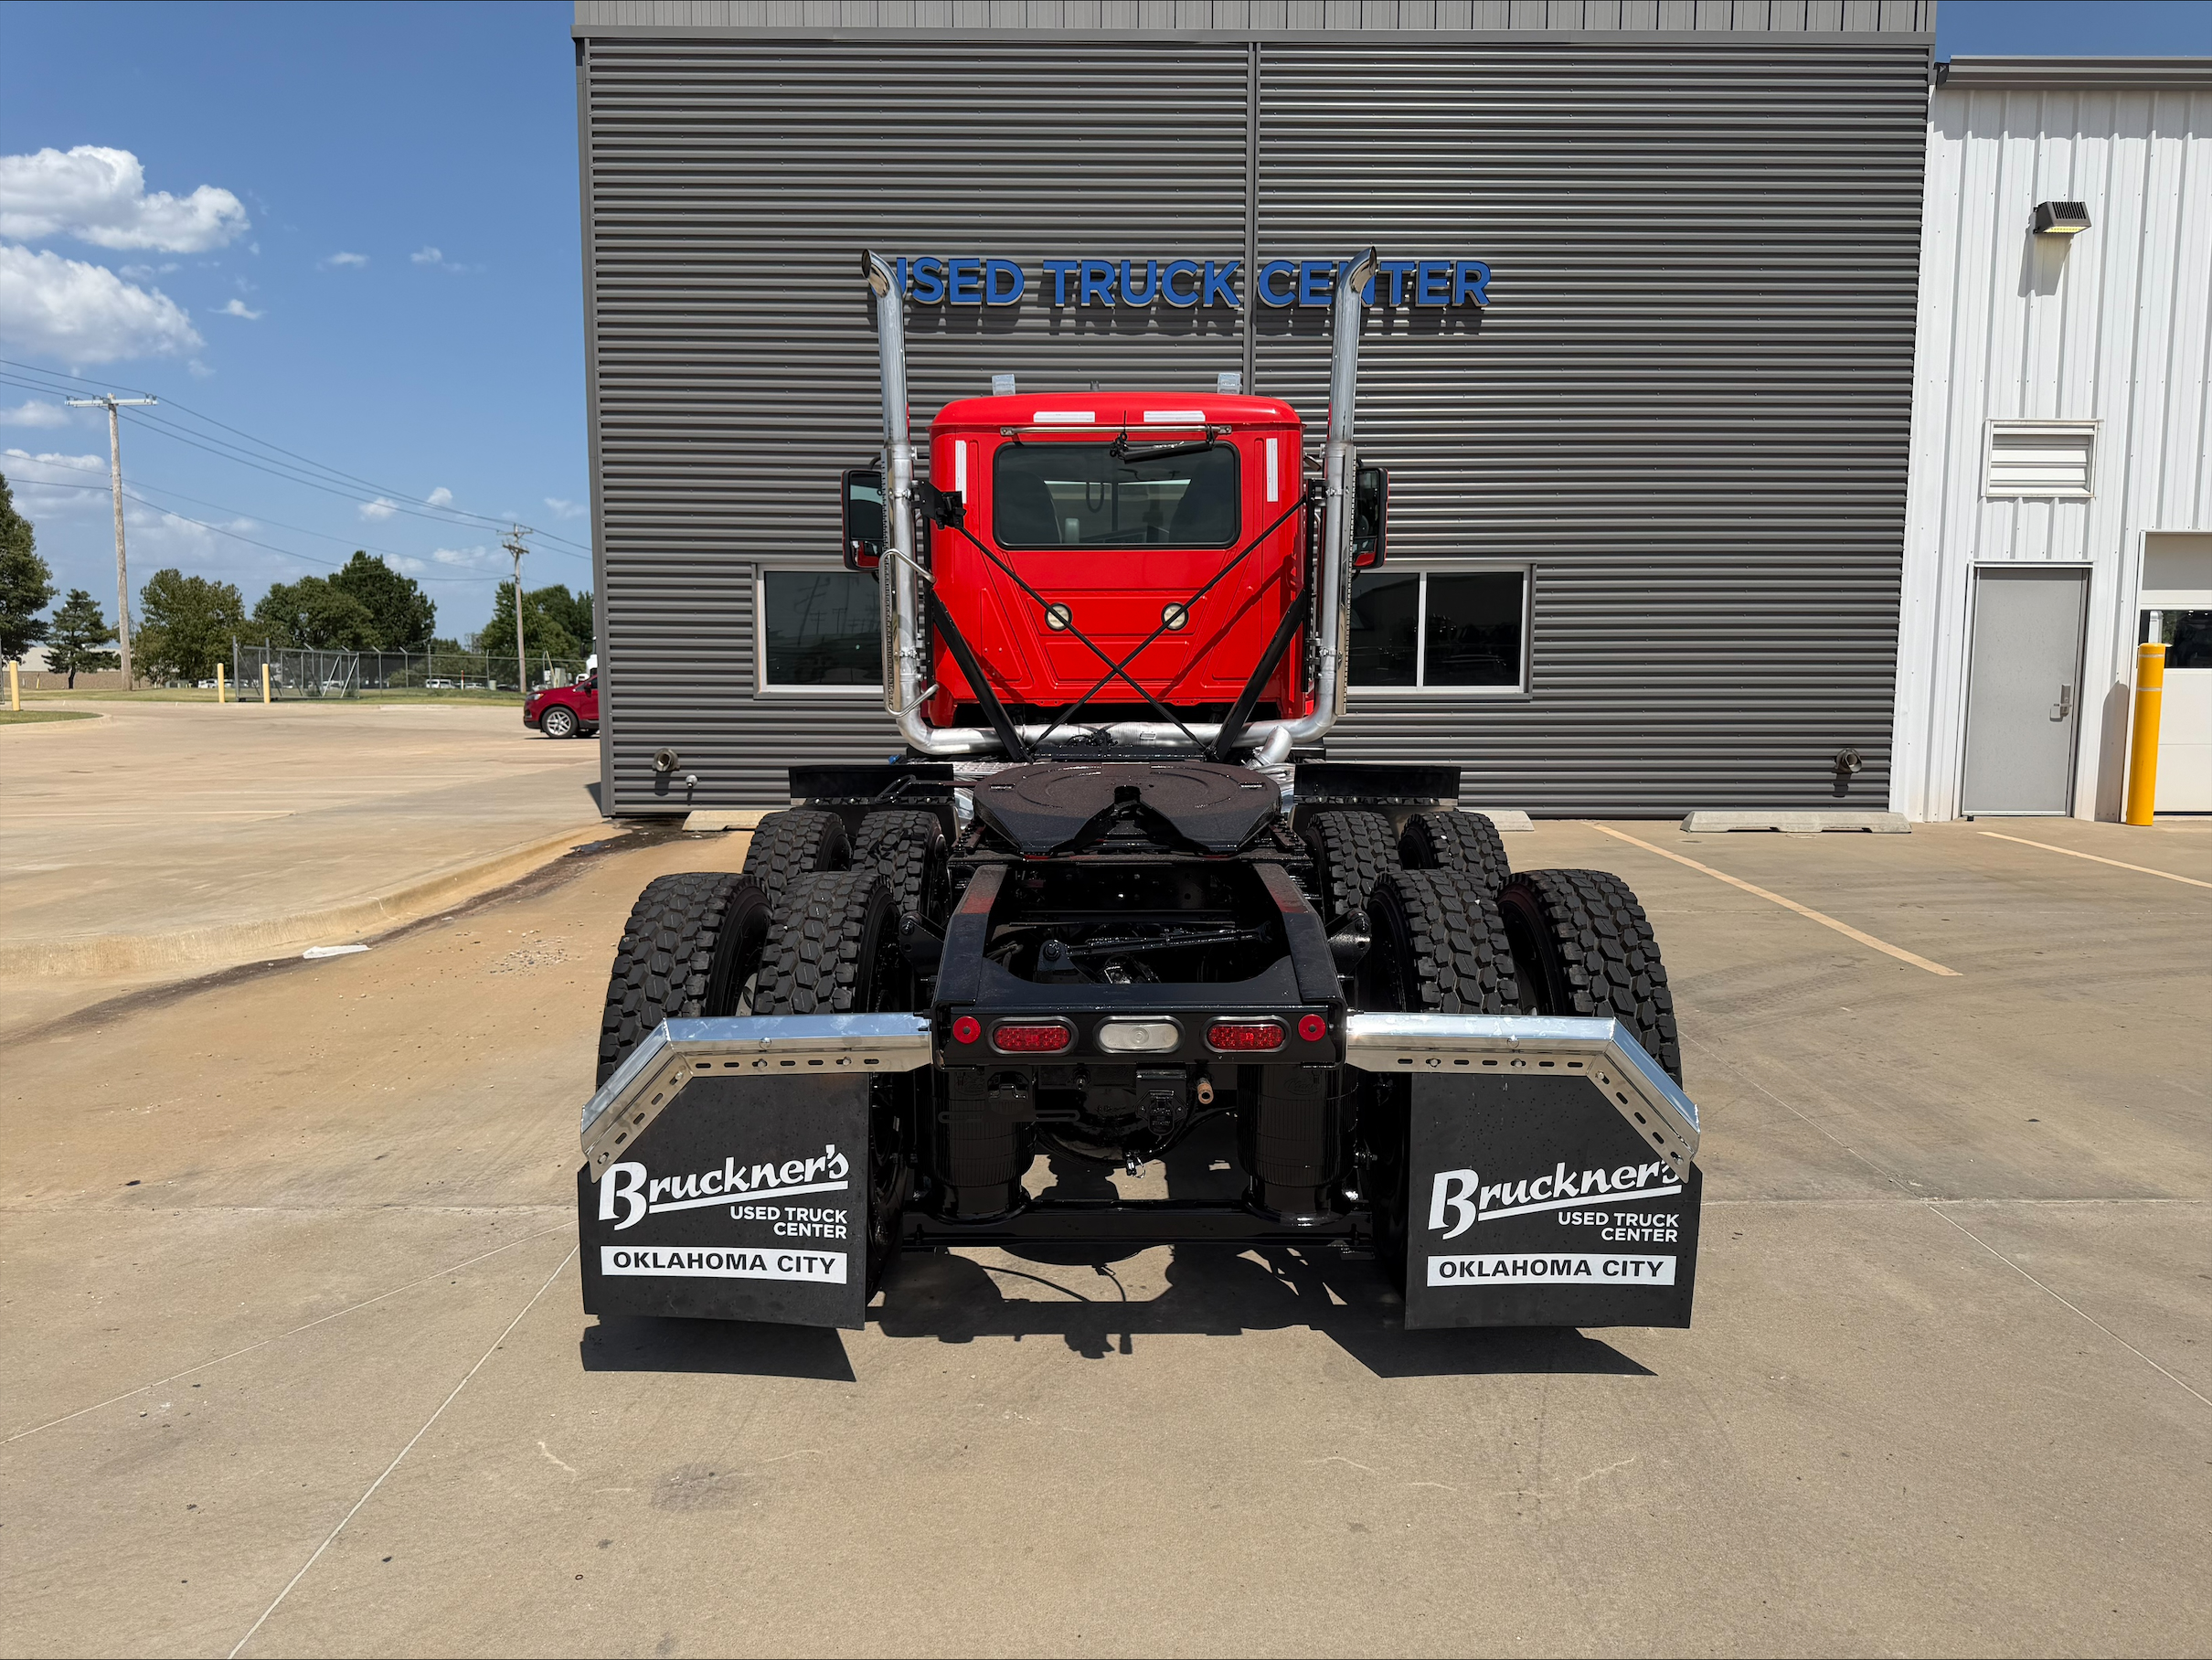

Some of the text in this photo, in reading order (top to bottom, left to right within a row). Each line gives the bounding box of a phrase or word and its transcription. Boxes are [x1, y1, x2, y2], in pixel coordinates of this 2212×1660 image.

[1042, 259, 1241, 308] TRUCK
[599, 1144, 849, 1231] Bruckner's
[730, 1205, 848, 1224] USED TRUCK
[1558, 1211, 1680, 1228] USED TRUCK
[773, 1221, 847, 1240] CENTER
[1601, 1227, 1678, 1243] CENTER
[612, 1251, 836, 1274] OKLAHOMA CITY
[1439, 1259, 1664, 1278] OKLAHOMA CITY
